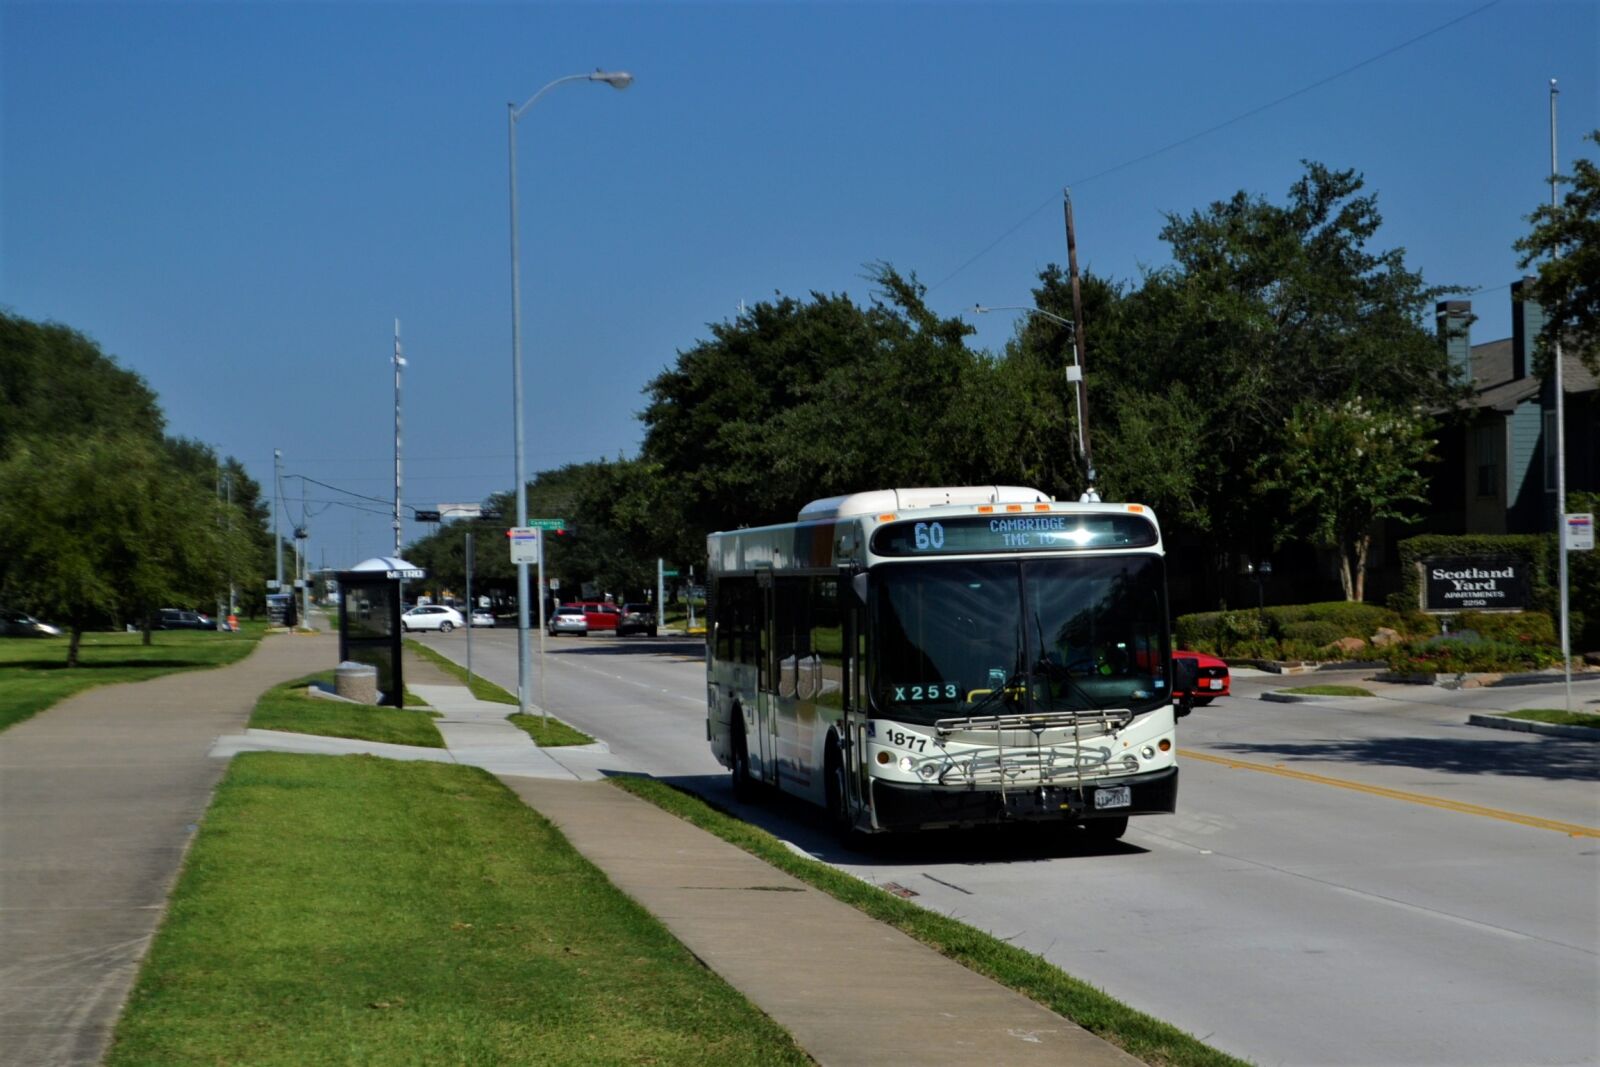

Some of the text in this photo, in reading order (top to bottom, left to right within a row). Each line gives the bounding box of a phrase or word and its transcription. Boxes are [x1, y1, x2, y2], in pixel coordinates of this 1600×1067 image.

[990, 518, 1066, 532] CAMBRIDGE
[914, 522, 944, 549] 60
[1002, 533, 1030, 546] TMC
[1432, 567, 1514, 580] Scotland
[1451, 579, 1496, 591] Yard
[1444, 590, 1505, 599] APARTMENTS
[886, 729, 926, 753] 1877
